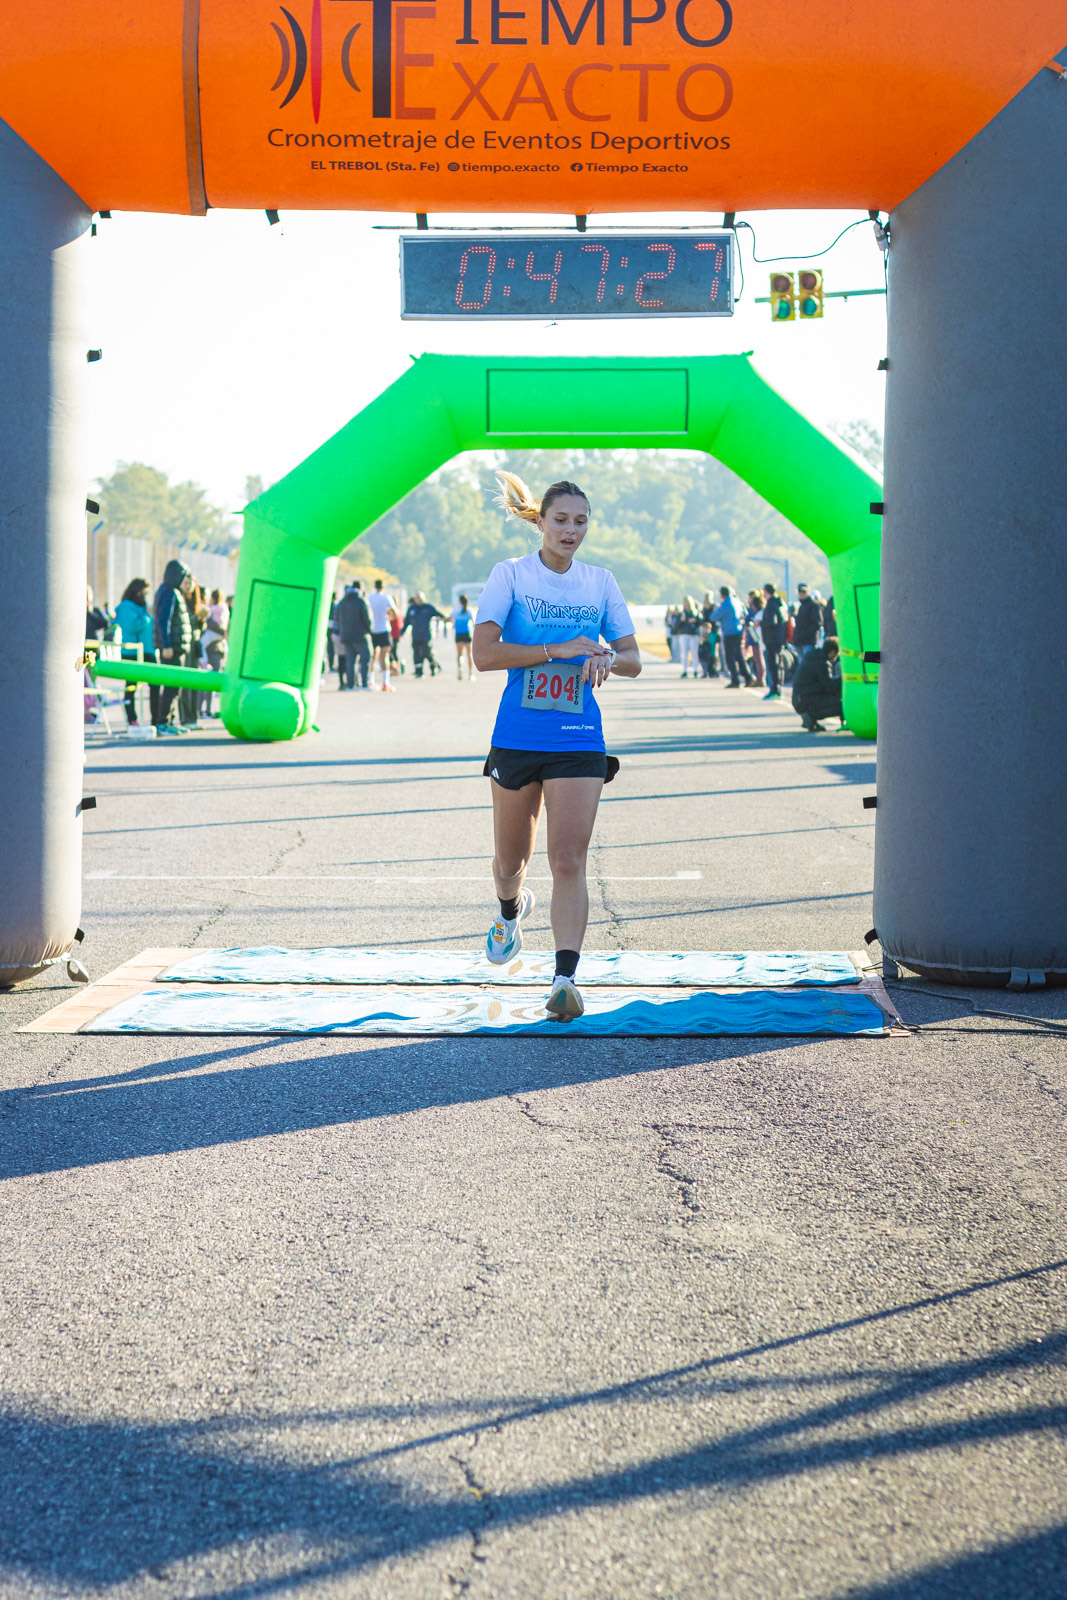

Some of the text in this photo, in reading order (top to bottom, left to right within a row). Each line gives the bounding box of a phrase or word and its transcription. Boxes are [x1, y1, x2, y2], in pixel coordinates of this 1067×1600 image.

[267, 128, 731, 154] Cronometraje de Eventos Deportivos
[311, 160, 440, 172] EL TREBOL (Sta. Fe)
[462, 162, 560, 174] tiempo.exacto
[585, 162, 689, 174] Tiempo Exacto
[455, 243, 724, 310] 0:47:27
[527, 669, 535, 700] TIEMPO
[534, 672, 575, 702] 204
[573, 674, 581, 706] EXACTO
